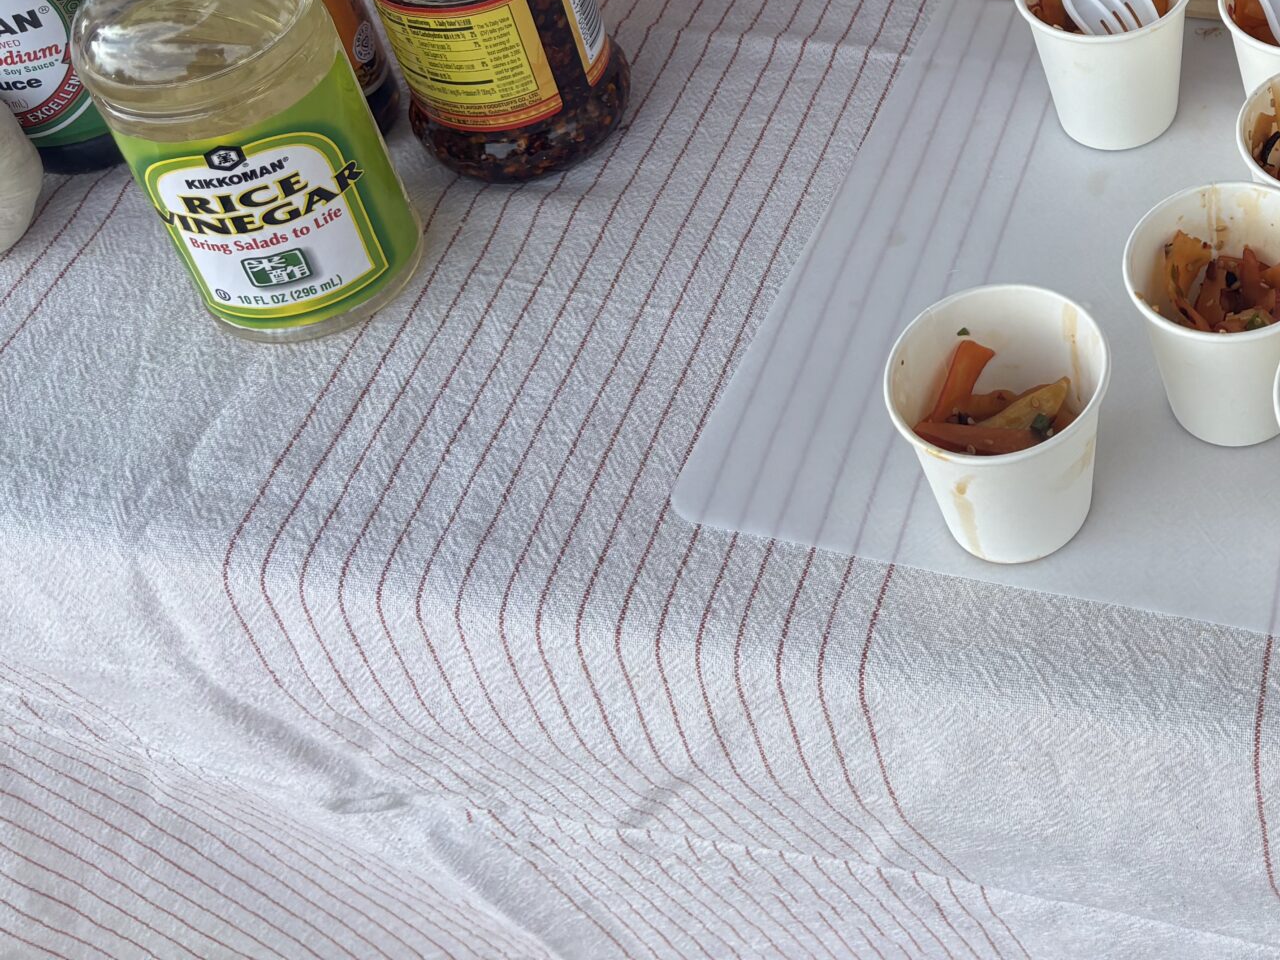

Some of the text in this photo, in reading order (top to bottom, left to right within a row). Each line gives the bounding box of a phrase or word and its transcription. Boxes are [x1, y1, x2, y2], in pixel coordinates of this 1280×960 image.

[3, 67, 22, 76] Soy
[155, 160, 363, 235] VINEGAR
[179, 171, 308, 215] RICE
[189, 207, 343, 255] Bring Salads to Life
[237, 274, 344, 305] 10 FL OZ (296 mL)
